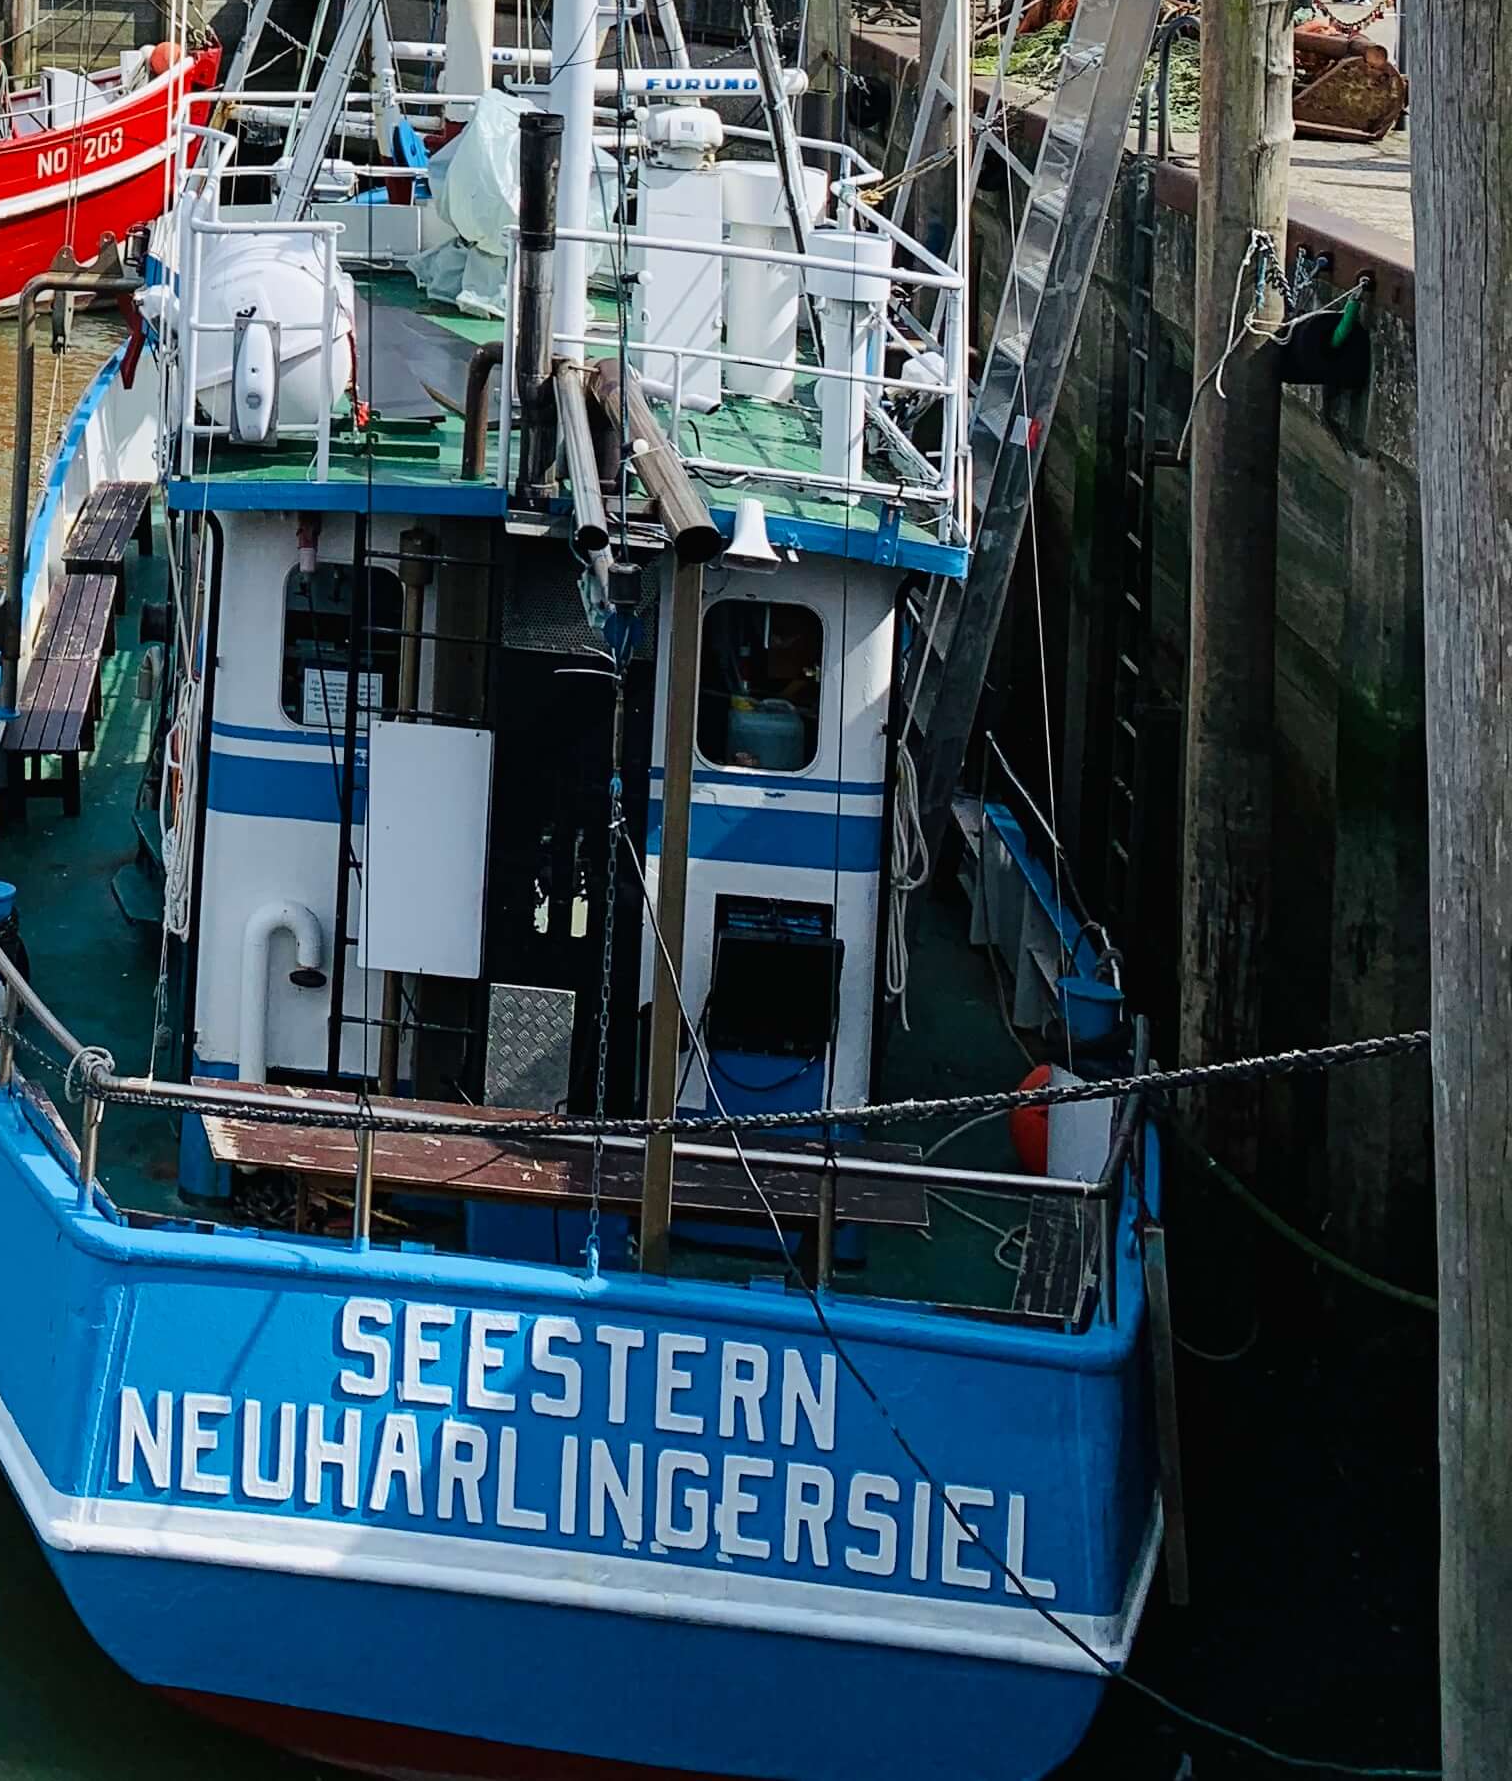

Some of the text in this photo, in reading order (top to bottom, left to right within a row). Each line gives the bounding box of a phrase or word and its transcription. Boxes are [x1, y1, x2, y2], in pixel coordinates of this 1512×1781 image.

[645, 78, 759, 91] FURUNO
[37, 126, 124, 180] NO 203
[340, 1297, 838, 1451] SEESTERN
[117, 1385, 1056, 1601] NEUHARLINGERSIEL
